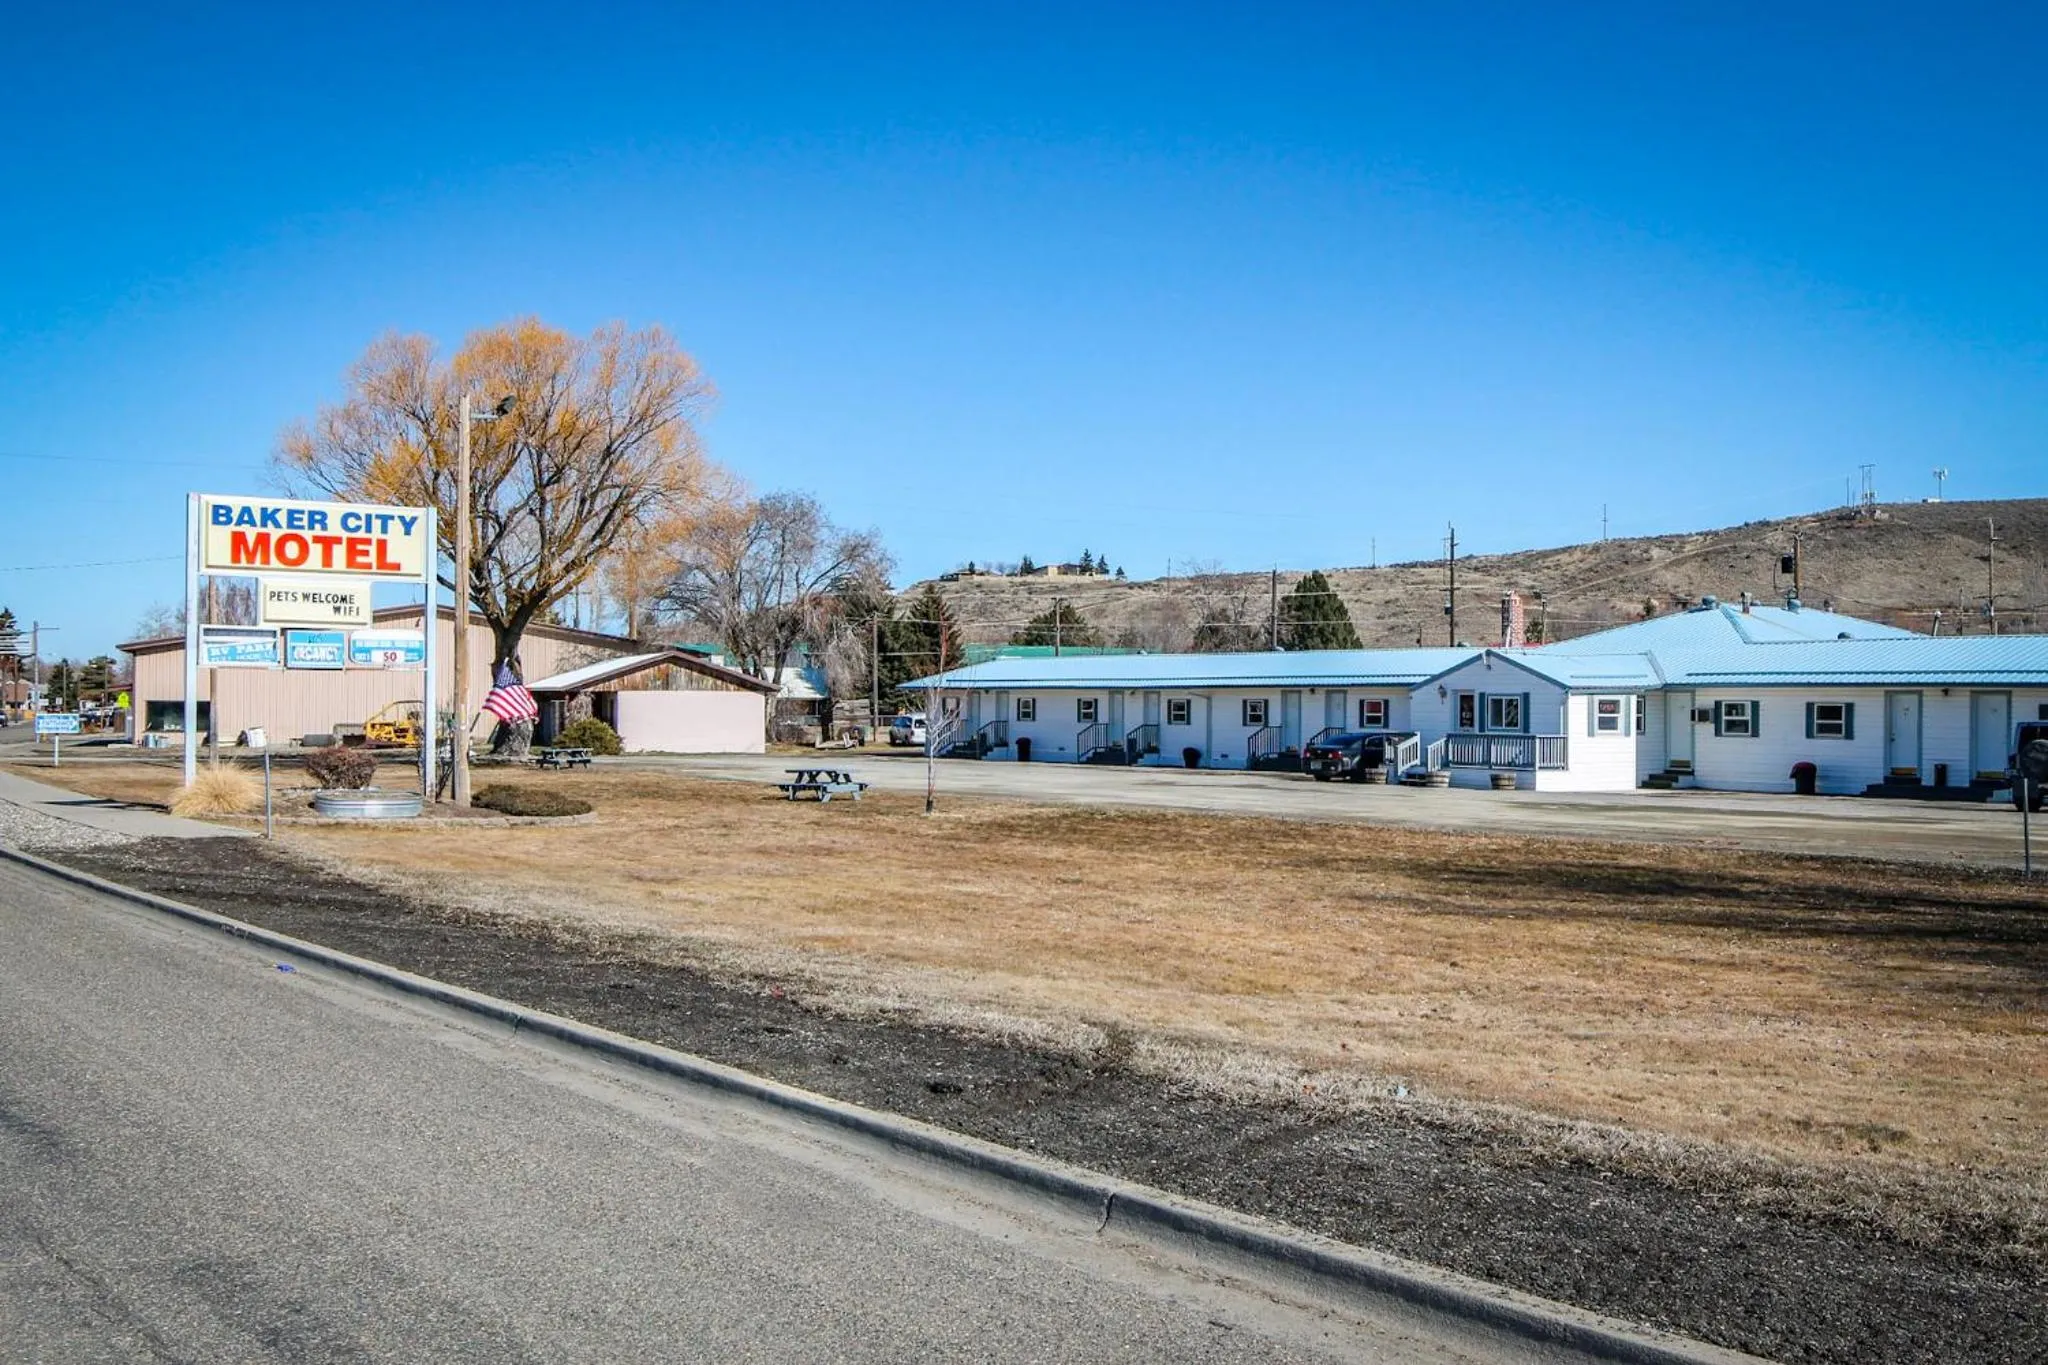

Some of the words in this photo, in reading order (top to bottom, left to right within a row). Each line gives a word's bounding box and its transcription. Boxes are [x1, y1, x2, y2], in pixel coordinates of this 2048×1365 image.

[211, 504, 328, 531] BAKER
[340, 511, 418, 536] CITY
[230, 530, 401, 571] MOTEL
[269, 590, 298, 602] PETS
[301, 592, 356, 605] WELCOME
[332, 605, 360, 616] WIFI
[383, 651, 398, 662] 50
